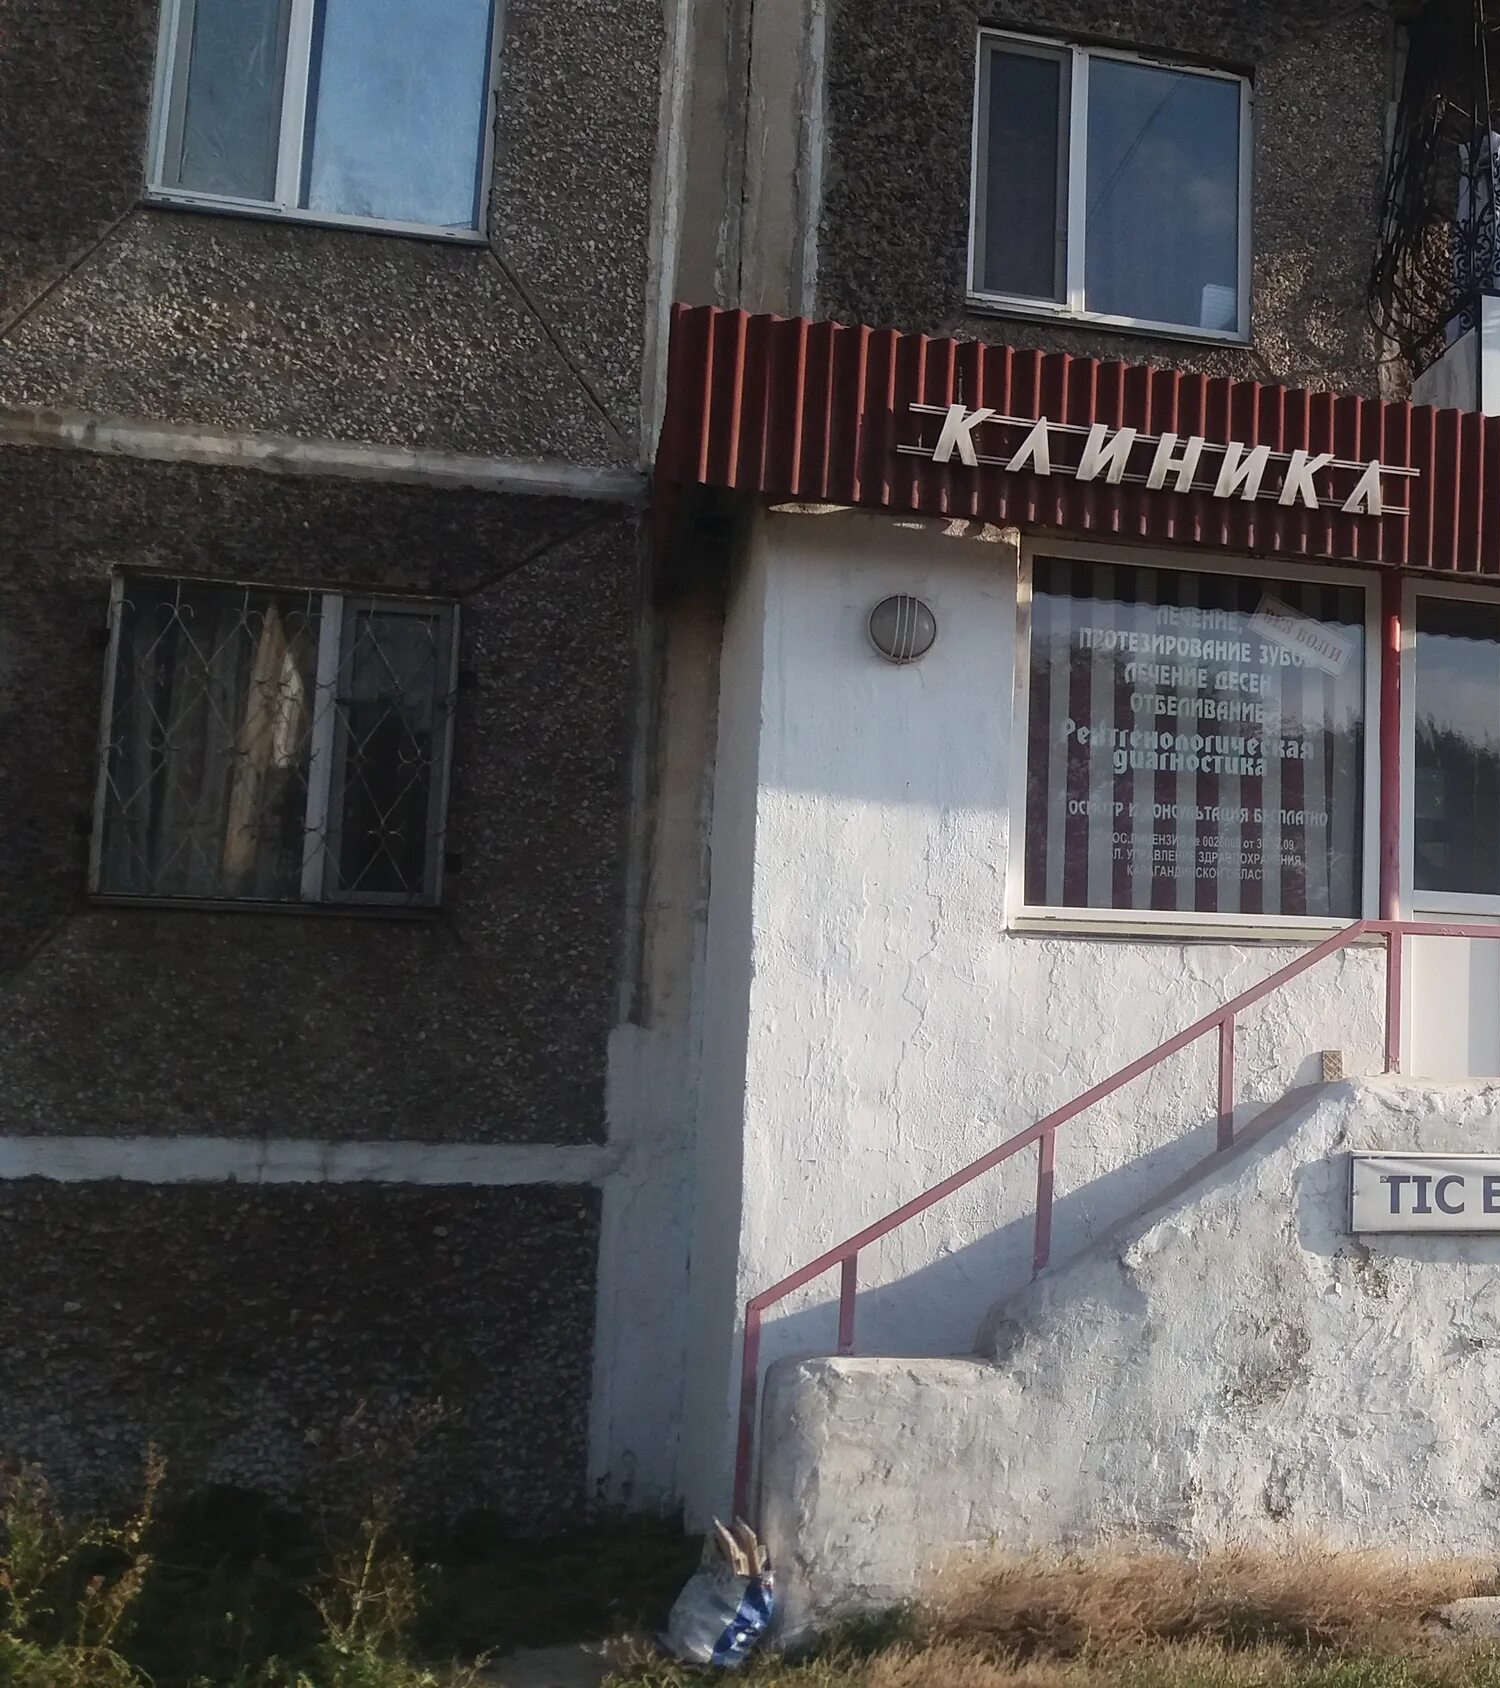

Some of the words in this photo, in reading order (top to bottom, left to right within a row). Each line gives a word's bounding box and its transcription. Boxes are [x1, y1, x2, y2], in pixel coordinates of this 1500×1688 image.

[932, 404, 1383, 515] КЛИНИКА
[1079, 627, 1251, 663] ПРОТЕЗИРОВАНИЕ
[1296, 628, 1343, 662] БОЛИ
[1124, 662, 1207, 688] ЛЕЧЕНИЕ
[1215, 670, 1272, 695] ДЕСЕН
[1130, 692, 1267, 722] ОТБЕЛИВАНИЕ
[1113, 750, 1268, 777] диагностика
[1386, 1173, 1467, 1215] ТІС
